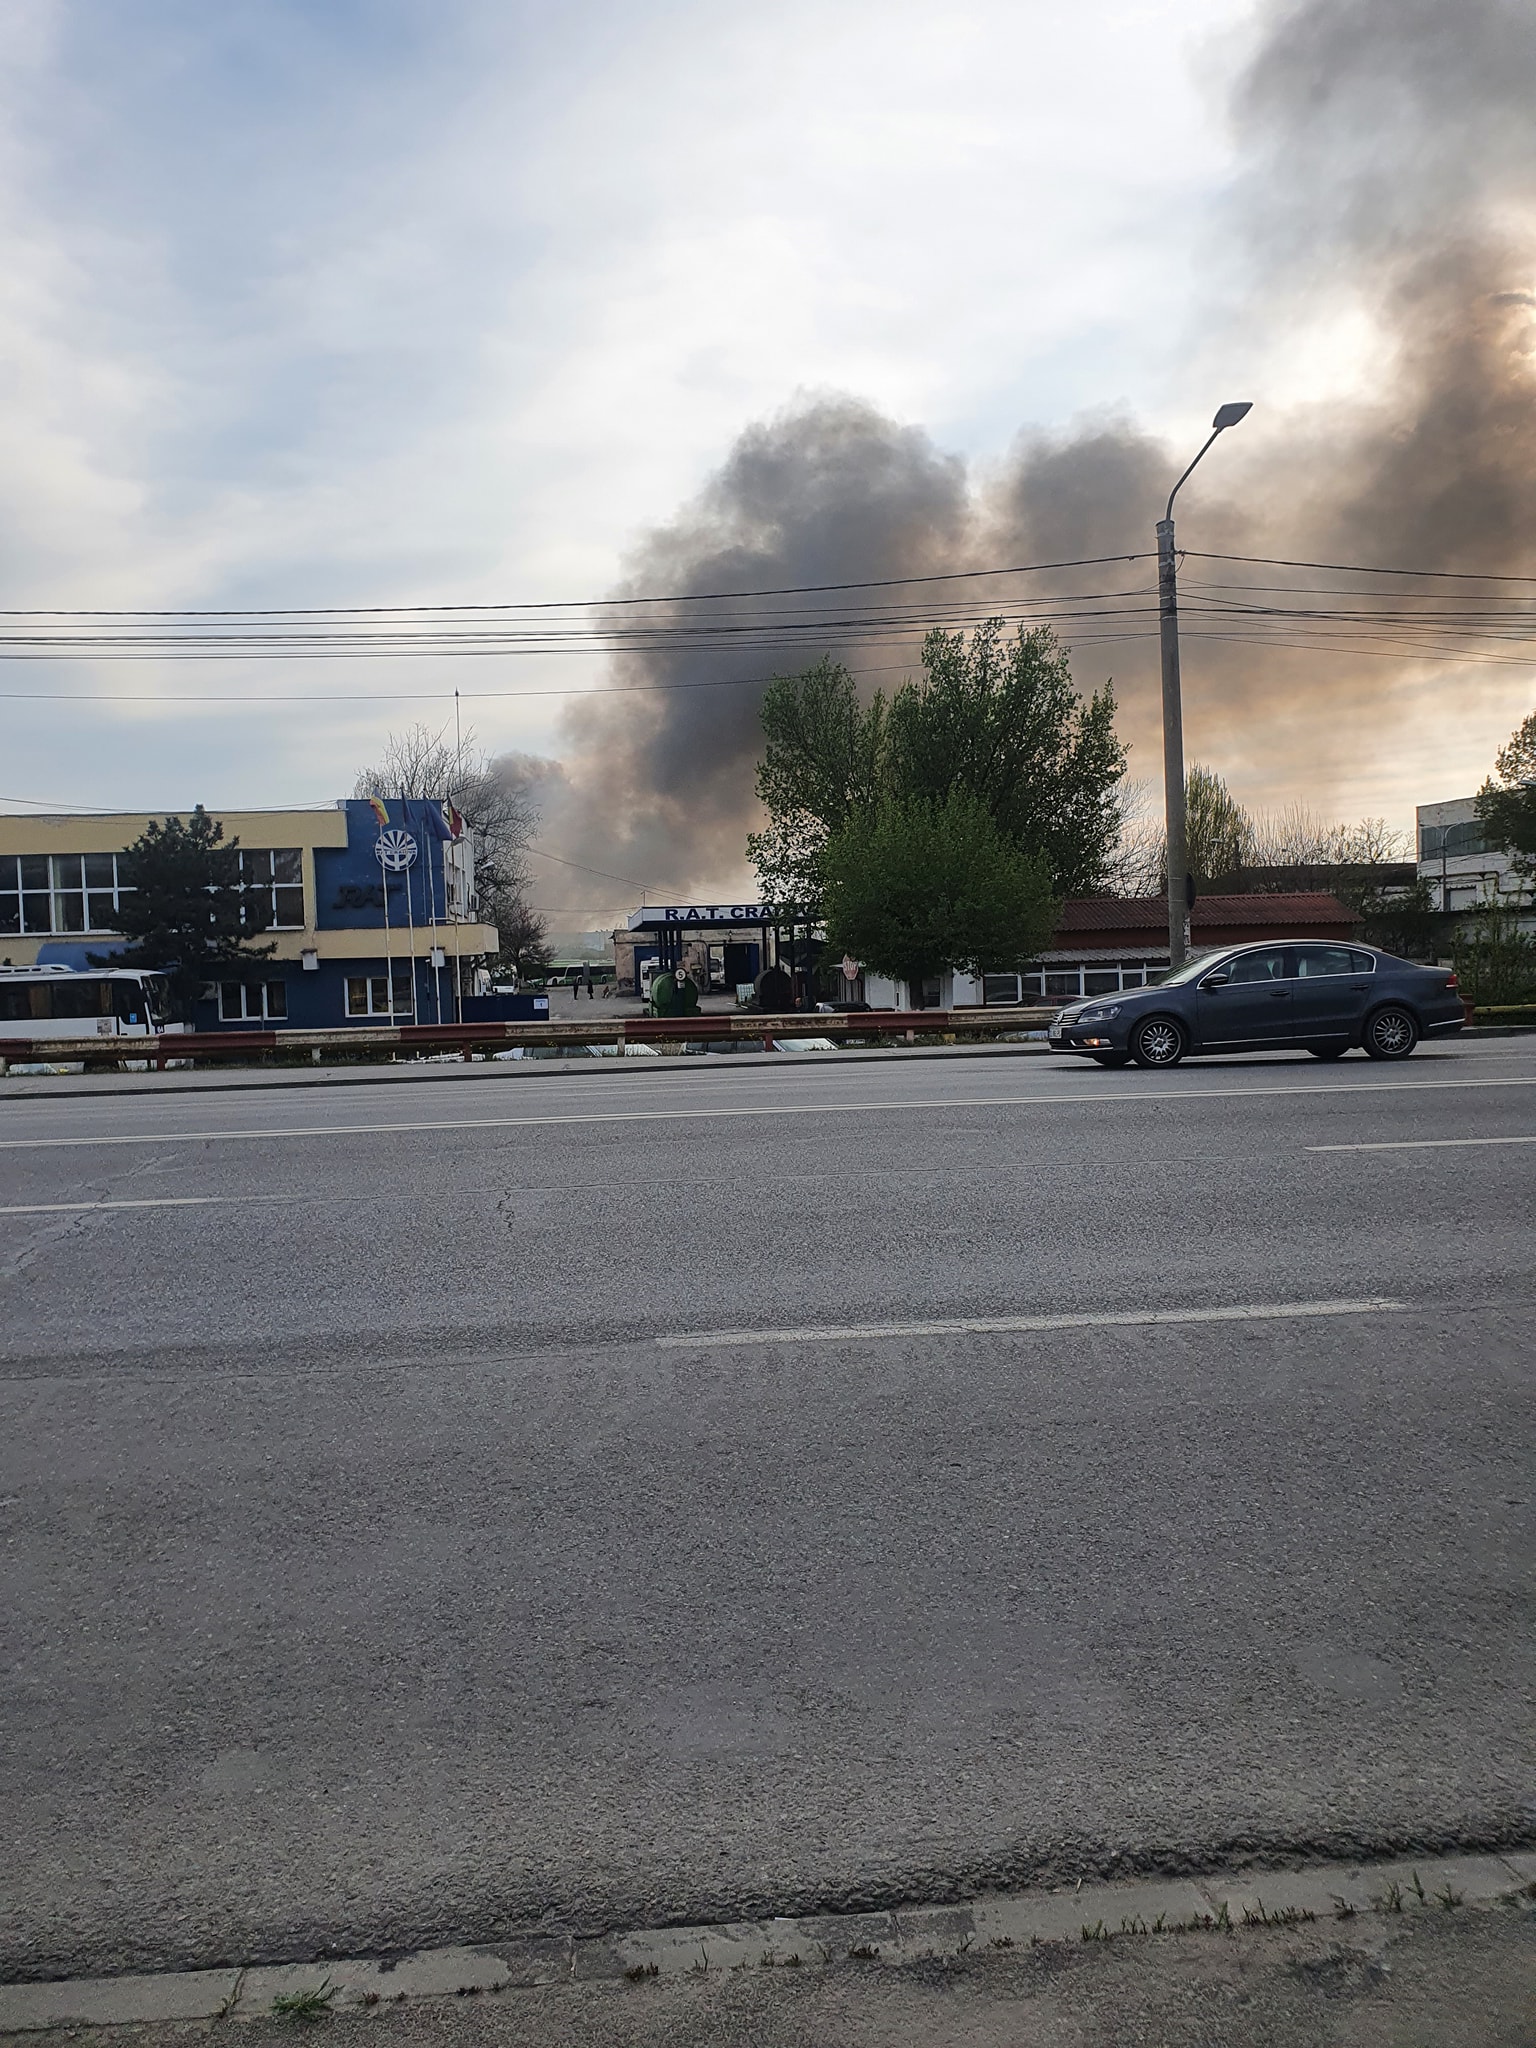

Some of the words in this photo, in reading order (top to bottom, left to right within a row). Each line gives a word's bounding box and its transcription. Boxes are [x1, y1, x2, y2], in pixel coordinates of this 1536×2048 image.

[665, 908, 724, 921] R.A.T.
[844, 960, 858, 971] STOP
[678, 971, 684, 979] 5
